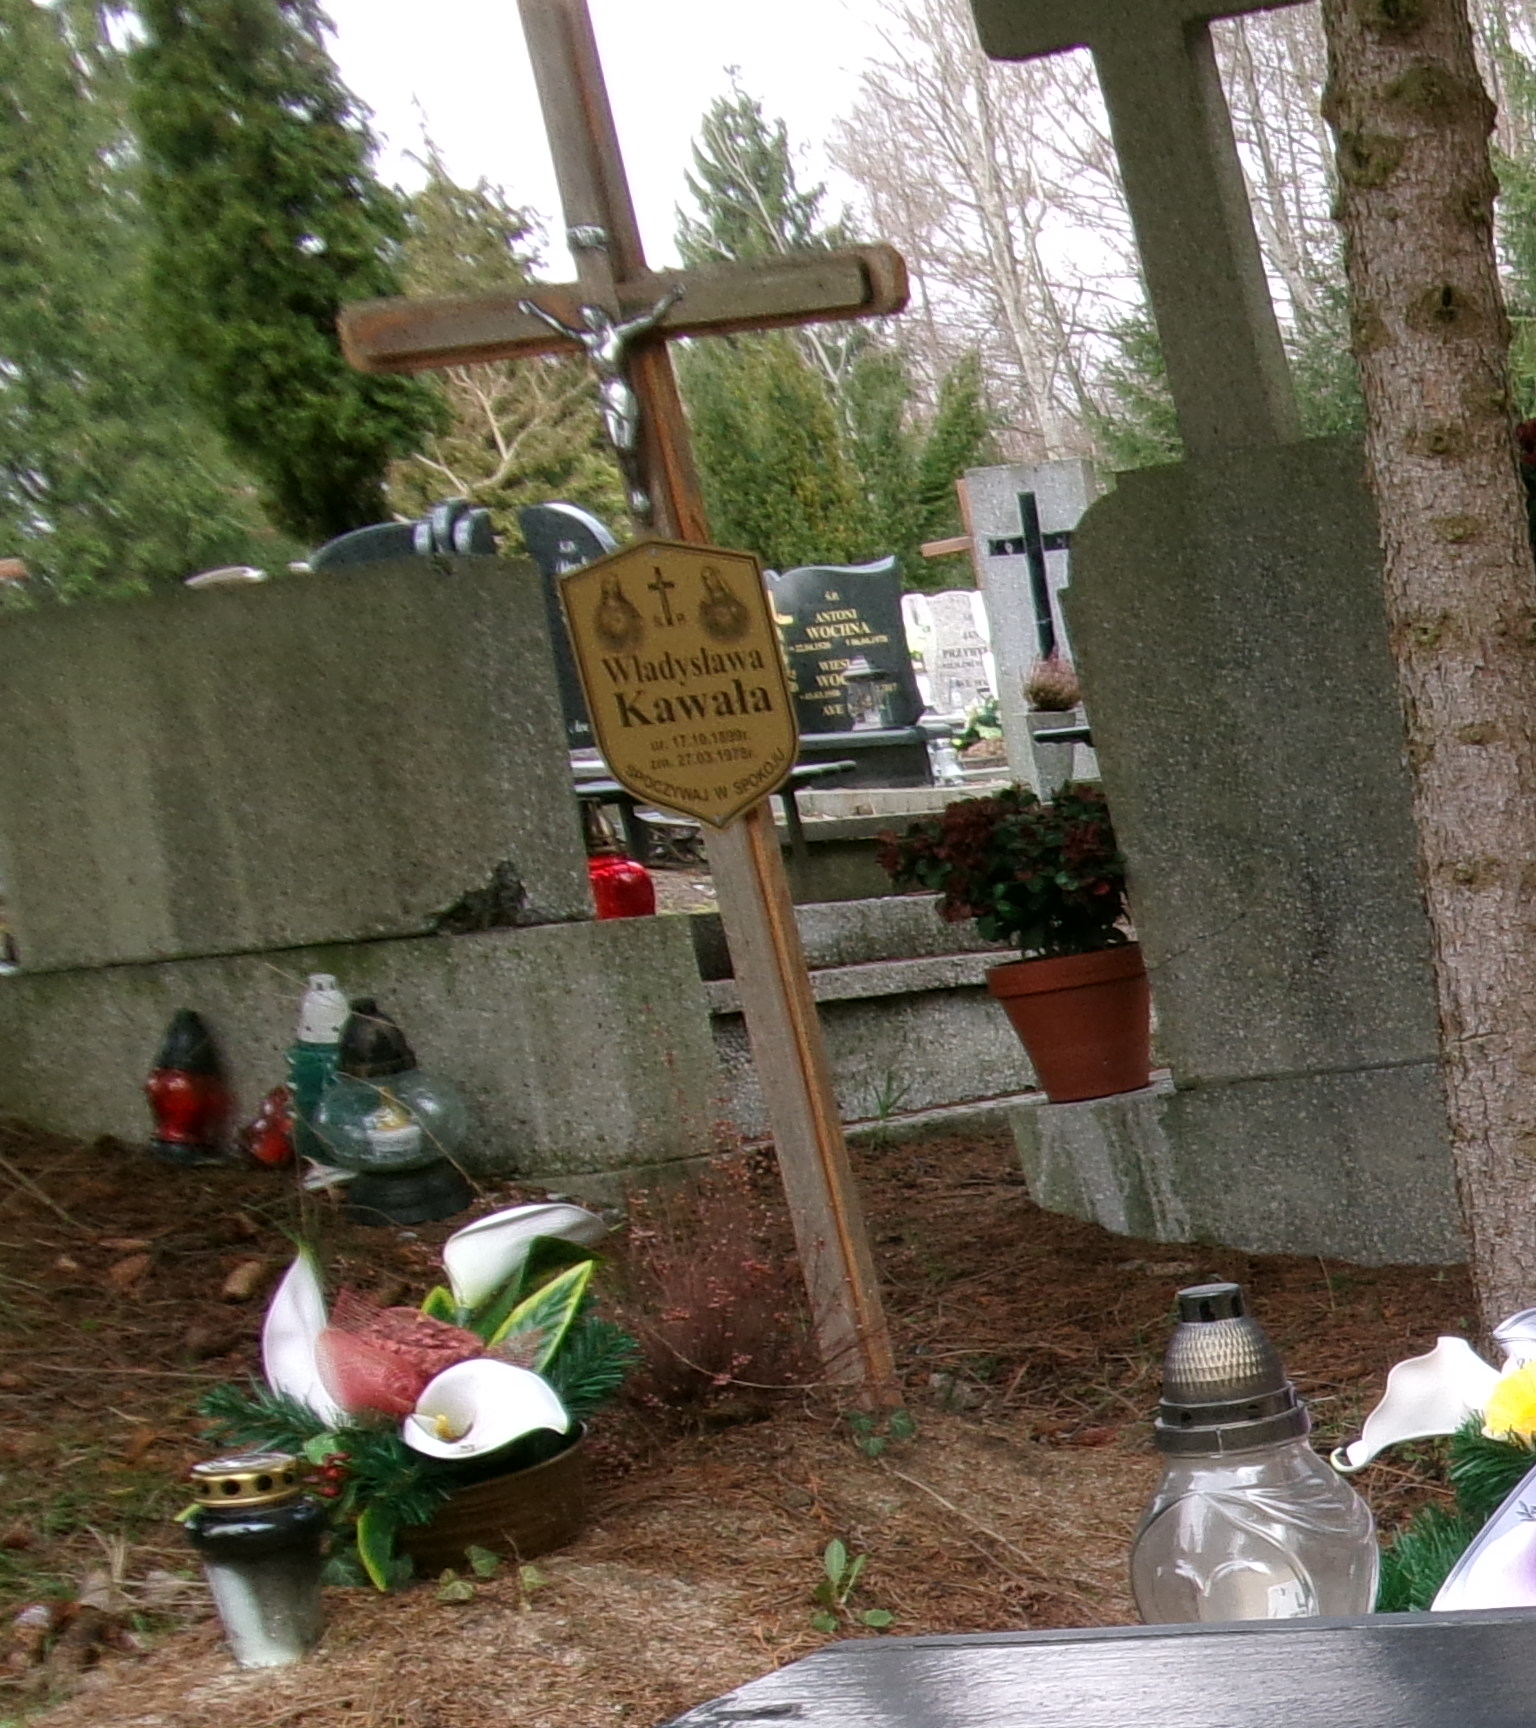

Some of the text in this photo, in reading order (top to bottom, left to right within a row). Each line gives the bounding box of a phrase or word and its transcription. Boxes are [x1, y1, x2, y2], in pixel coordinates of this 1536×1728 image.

[601, 647, 765, 687] Władysława
[614, 679, 774, 728] Kawała
[714, 786, 728, 801] W
[732, 747, 786, 796] SPOKOJU
